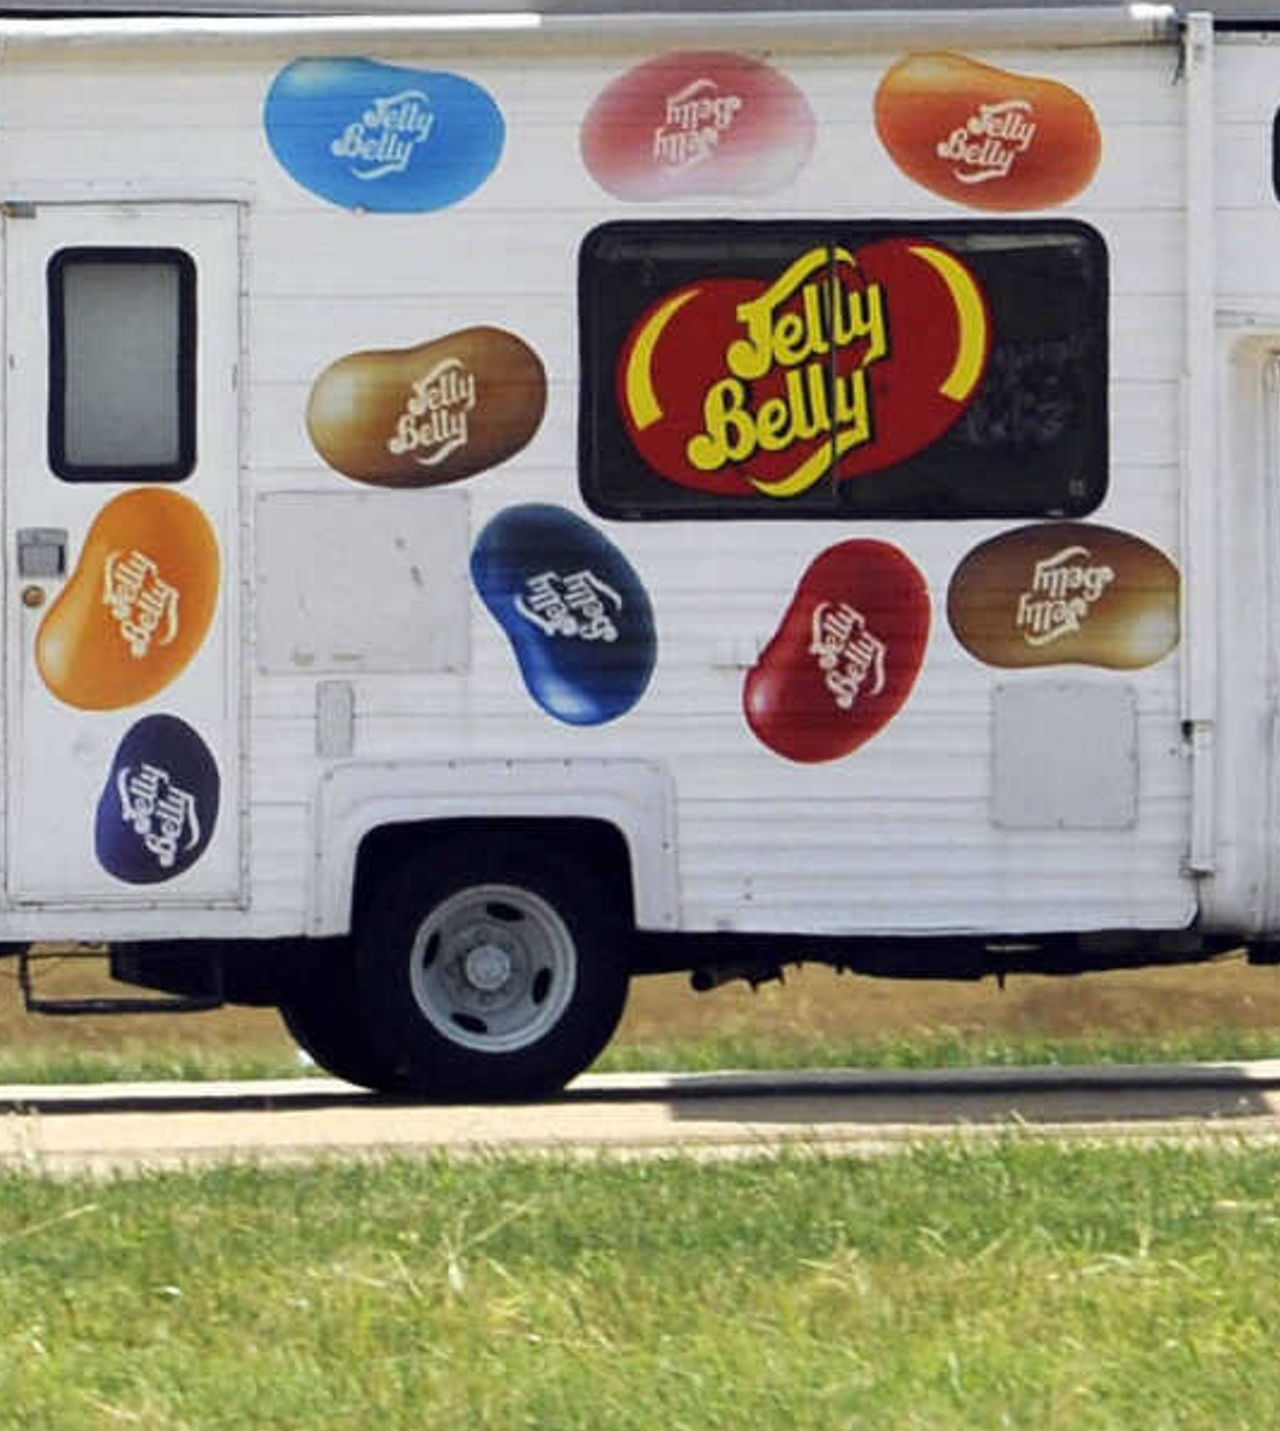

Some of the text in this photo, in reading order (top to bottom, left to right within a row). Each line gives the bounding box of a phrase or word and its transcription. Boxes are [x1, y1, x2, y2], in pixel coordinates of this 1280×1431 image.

[363, 90, 434, 143] Jelly
[666, 78, 742, 130] Belly
[967, 99, 1037, 151] Jelly
[330, 123, 414, 180] Belly
[651, 125, 720, 170] Jelly
[937, 128, 1016, 184] Belly
[726, 247, 887, 379] Jelly
[407, 358, 477, 416] Jelly
[389, 410, 468, 466] Belly
[687, 363, 870, 497] Belly
[103, 549, 159, 621] Jelly
[513, 571, 577, 637] Jelly
[1032, 545, 1115, 602] Belly
[122, 581, 179, 658] Belly
[562, 570, 622, 643] Belly
[810, 602, 865, 669] Jelly
[1016, 594, 1088, 646] Jelly
[825, 630, 887, 708] Belly
[120, 763, 170, 835] Jelly
[144, 786, 200, 868] Belly
